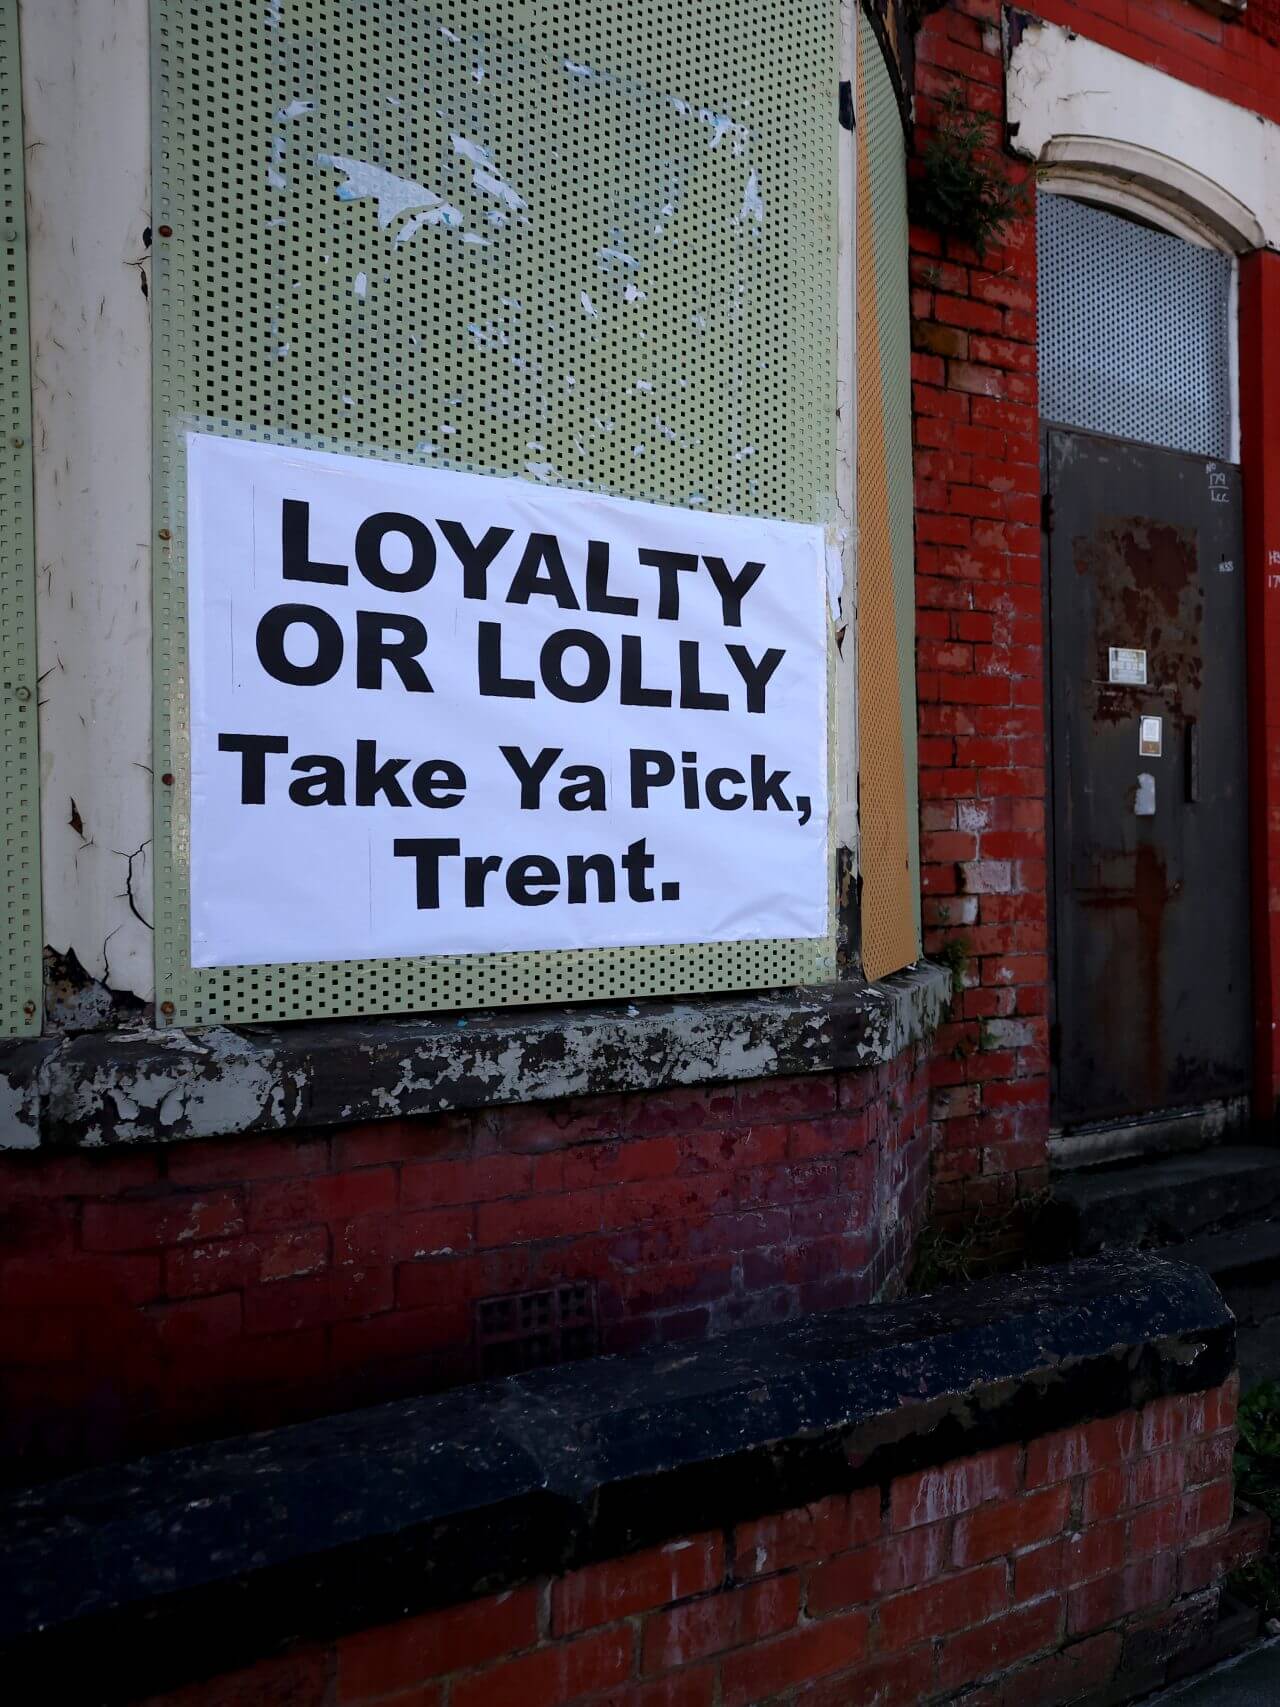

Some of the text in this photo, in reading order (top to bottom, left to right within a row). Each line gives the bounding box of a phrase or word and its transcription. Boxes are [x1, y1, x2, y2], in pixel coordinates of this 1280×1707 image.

[282, 498, 766, 627] LOYALTY
[255, 603, 786, 714] OR LOLLY
[218, 733, 812, 826] Take Ya Pick,
[393, 836, 680, 909] Trent.
